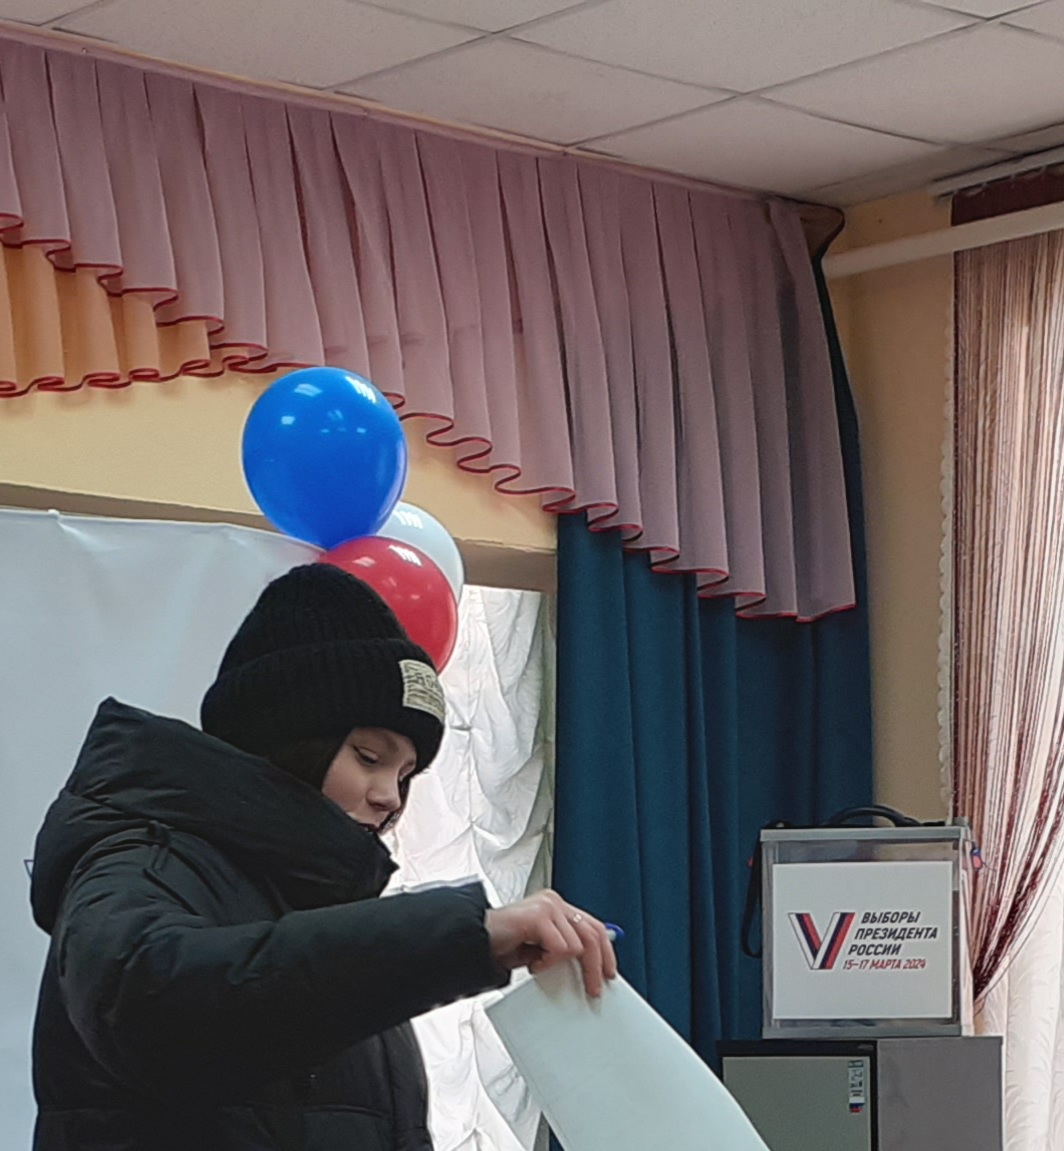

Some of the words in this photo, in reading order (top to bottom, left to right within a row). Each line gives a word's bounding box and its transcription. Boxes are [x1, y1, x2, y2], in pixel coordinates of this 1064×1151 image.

[861, 911, 921, 924] ВЫБОРЫ
[854, 927, 938, 941] ПРЕЗИДЕНТА
[848, 944, 902, 956] РОССИИ
[869, 959, 901, 970] МАРТА
[903, 958, 927, 969] 2024
